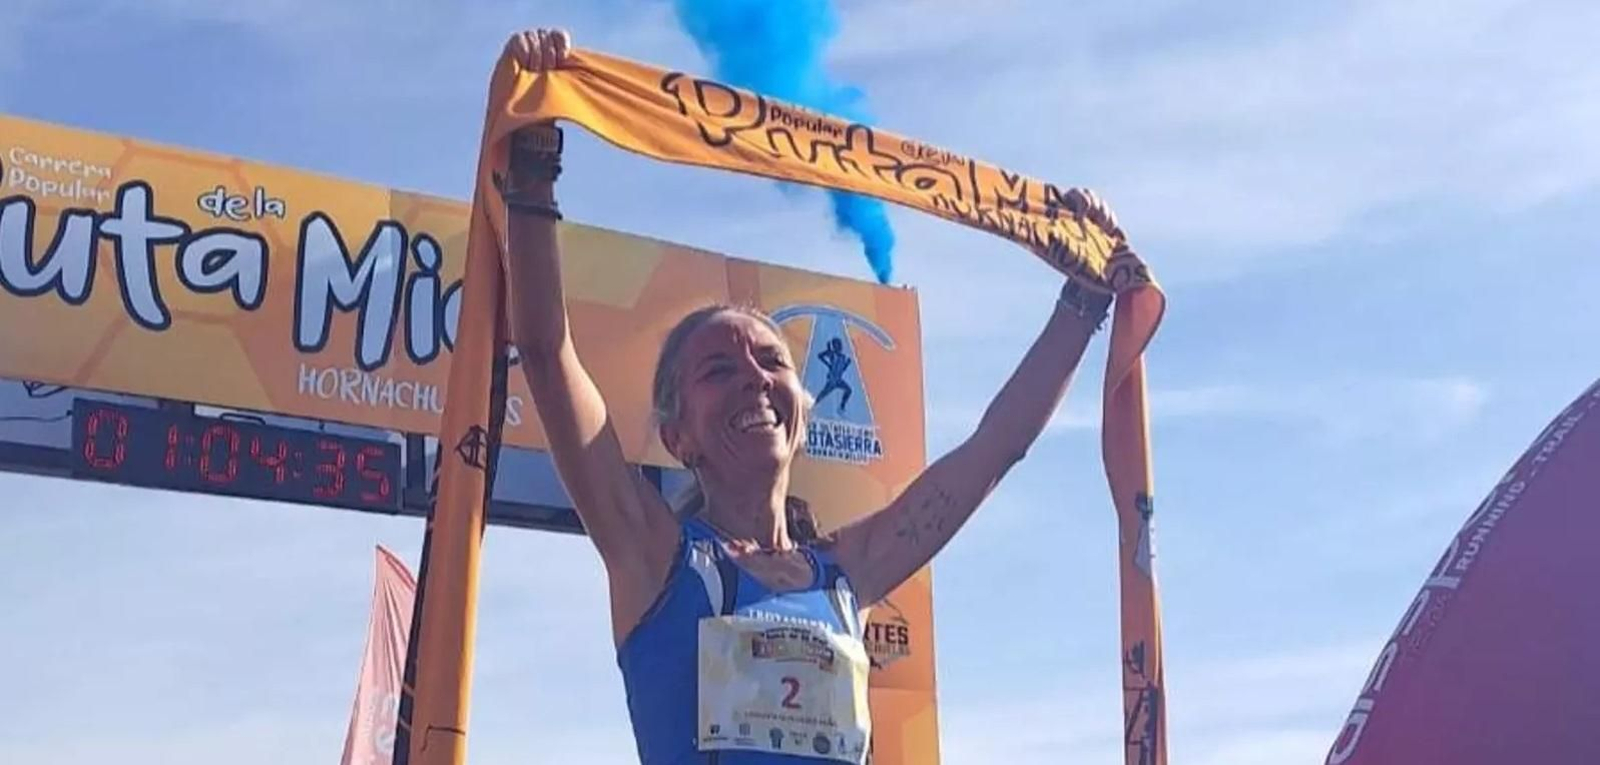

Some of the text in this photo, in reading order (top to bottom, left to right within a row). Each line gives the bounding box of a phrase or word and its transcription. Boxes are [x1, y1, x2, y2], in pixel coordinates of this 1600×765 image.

[769, 104, 844, 138] Popular
[9, 147, 112, 179] Carrera
[9, 166, 111, 205] Popular
[197, 185, 286, 221] de la
[0, 180, 269, 331] uta
[299, 363, 523, 426] HORNACHUS
[805, 427, 882, 456] OTASIERRA
[1454, 480, 1526, 572] RUNNING
[781, 676, 802, 709] 2
